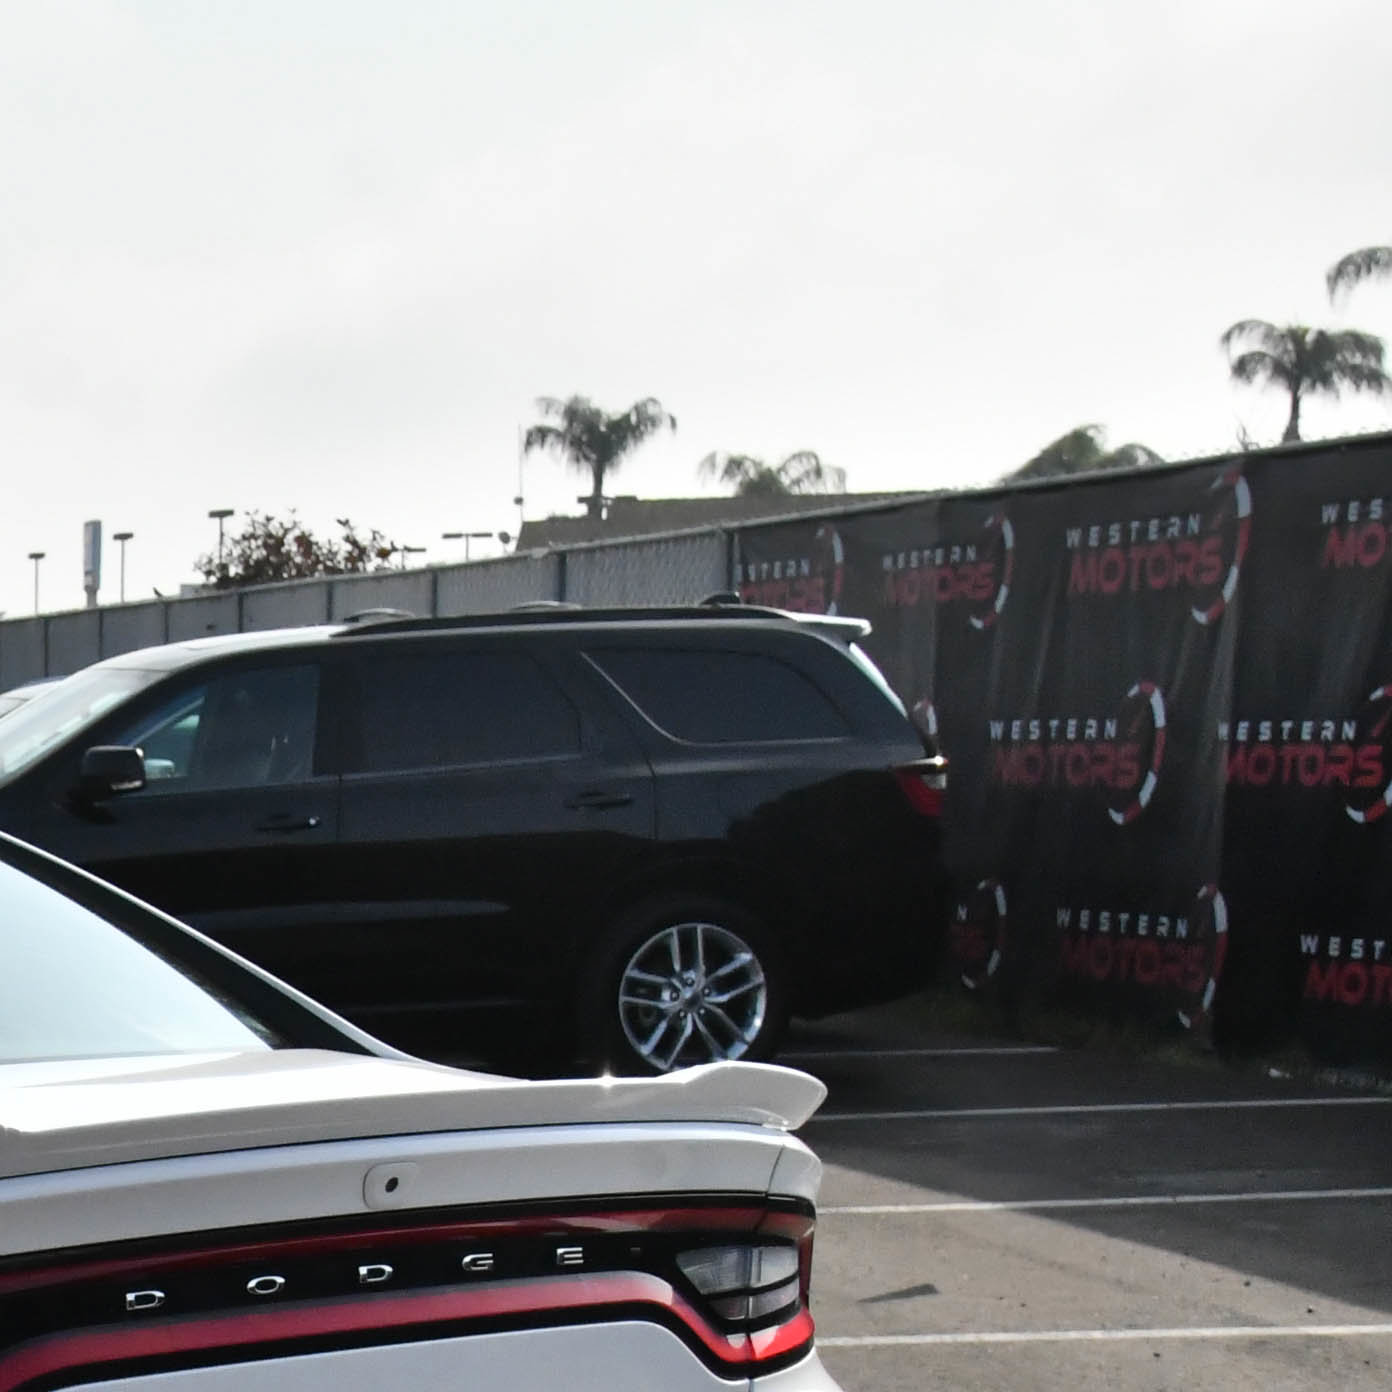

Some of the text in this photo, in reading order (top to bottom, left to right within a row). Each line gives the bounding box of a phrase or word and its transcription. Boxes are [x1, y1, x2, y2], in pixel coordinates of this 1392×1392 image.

[1066, 513, 1201, 548] WESTERN
[1068, 537, 1223, 594] MOTORS
[989, 718, 1117, 741] WESTERN
[1218, 719, 1356, 742] WESTERN
[993, 742, 1142, 789] MOTORS
[1056, 907, 1189, 938] WESTERN
[126, 1246, 585, 1310] DODGE
